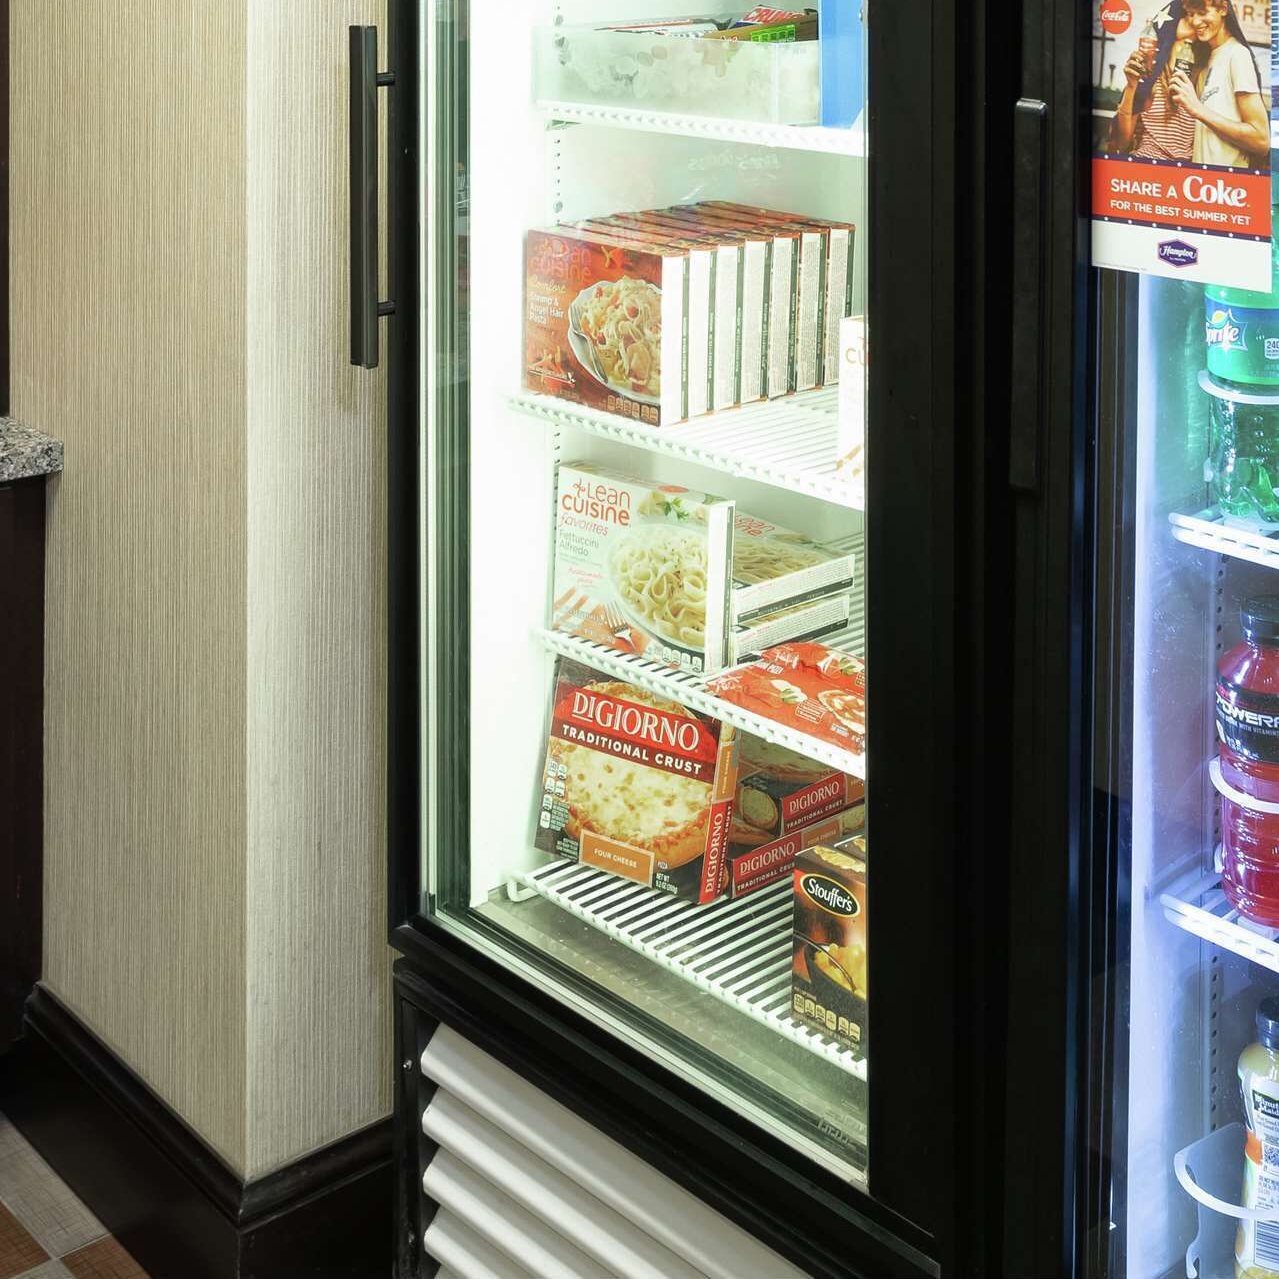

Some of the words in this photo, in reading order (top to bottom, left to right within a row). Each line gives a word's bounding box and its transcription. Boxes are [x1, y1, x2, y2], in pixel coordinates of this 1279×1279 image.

[1111, 178, 1162, 198] SHARE
[1167, 186, 1178, 199] A
[1183, 175, 1248, 208] Coke
[1110, 199, 1131, 212] FOR
[1133, 202, 1153, 214] THE
[1155, 205, 1181, 218] BEST
[1183, 208, 1228, 223] SUMMER
[1230, 213, 1251, 226] YET
[588, 481, 631, 509] Lean
[562, 724, 649, 762] TRADITIONAL
[655, 755, 702, 776] CRUST
[808, 878, 853, 912] Stouffer's
